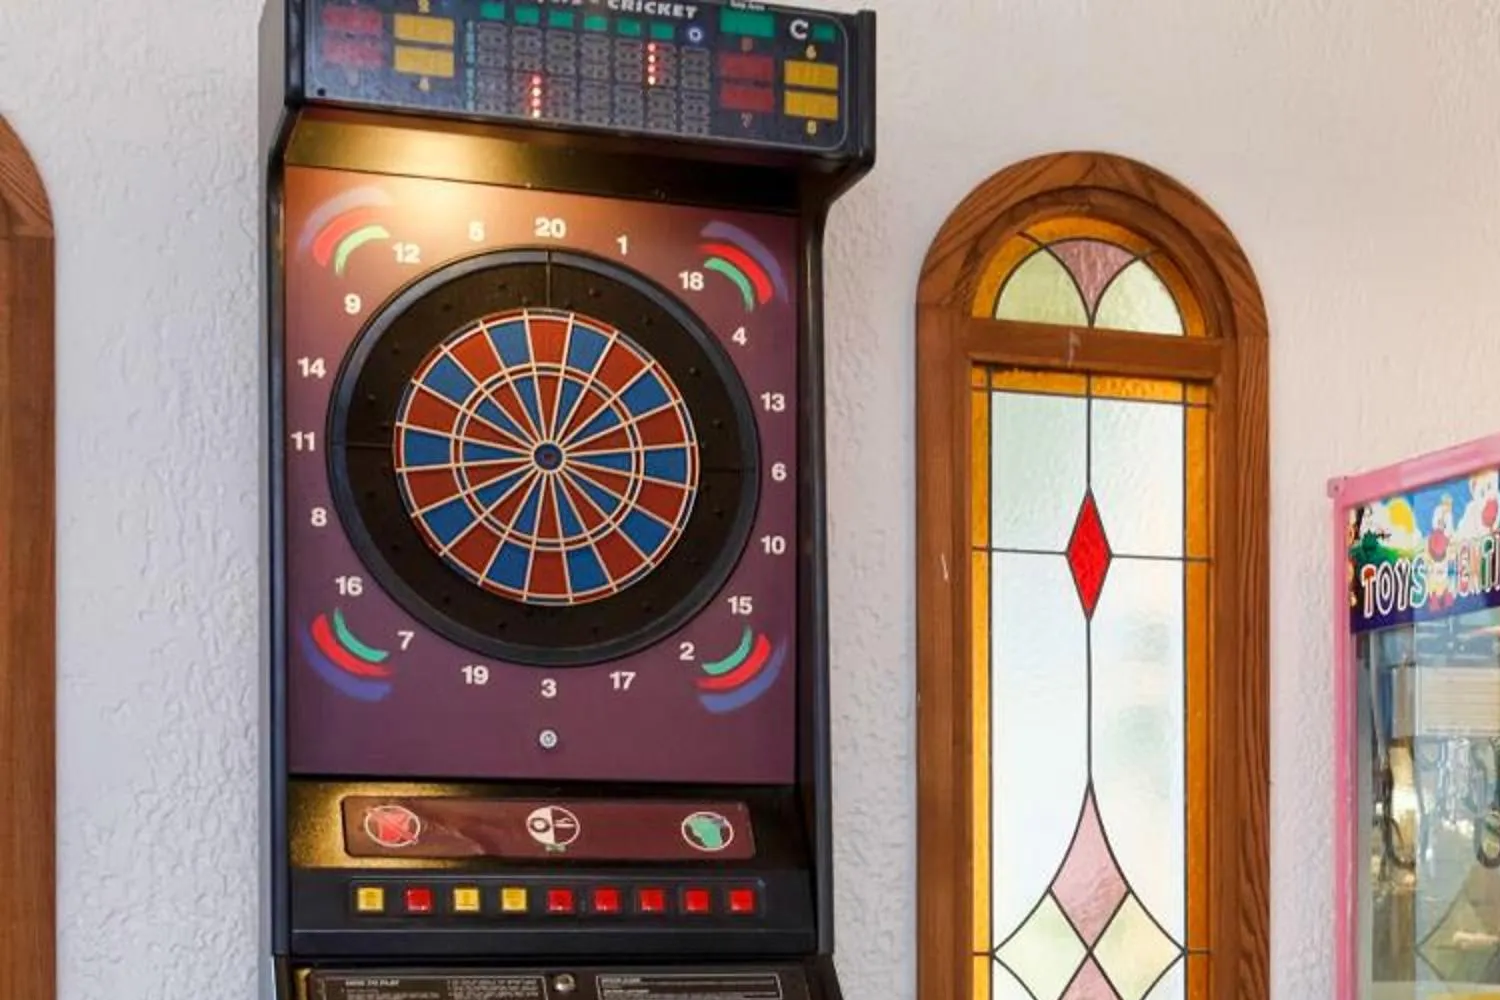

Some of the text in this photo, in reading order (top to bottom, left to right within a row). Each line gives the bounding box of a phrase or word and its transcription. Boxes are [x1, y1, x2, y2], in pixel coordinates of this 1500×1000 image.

[535, 217, 566, 238] 20
[392, 242, 421, 264] 12
[617, 235, 628, 255] 1
[679, 271, 705, 291] 18
[344, 293, 361, 315] 9
[732, 326, 747, 345] 4
[298, 357, 326, 378] 14
[761, 391, 785, 412] 13
[291, 431, 315, 451] 11
[771, 462, 787, 482] 6
[311, 507, 327, 527] 8
[761, 535, 786, 555] 10
[335, 575, 363, 596] 16
[1361, 553, 1429, 619] TOYS
[727, 595, 753, 615] 15
[397, 630, 415, 650] 7
[679, 641, 695, 661] 2
[461, 665, 489, 685] 19
[609, 671, 636, 690] 17
[541, 678, 557, 698] 3
